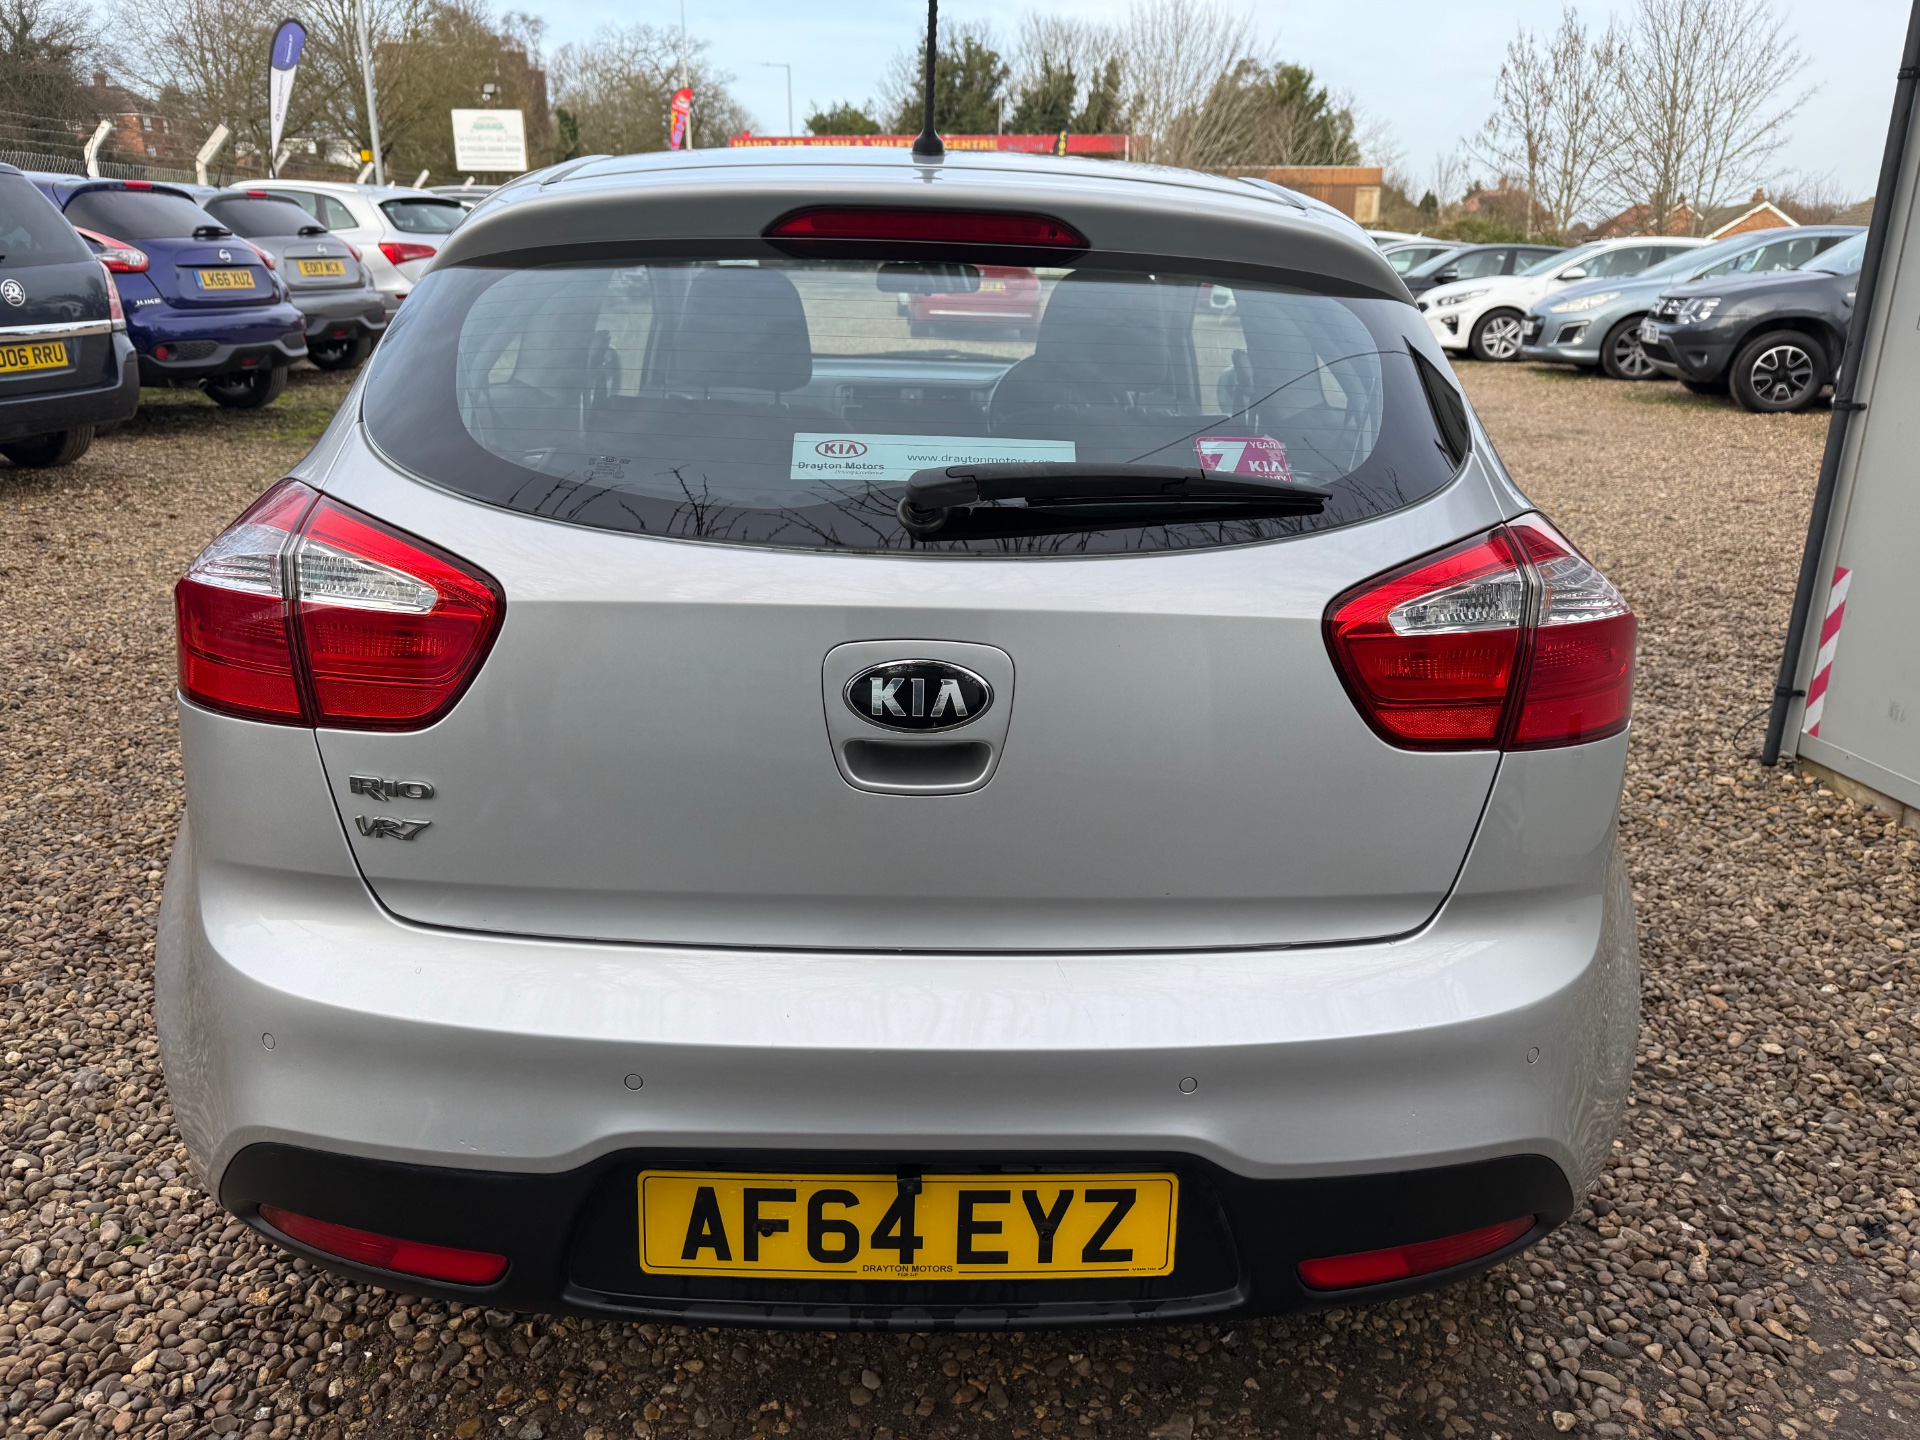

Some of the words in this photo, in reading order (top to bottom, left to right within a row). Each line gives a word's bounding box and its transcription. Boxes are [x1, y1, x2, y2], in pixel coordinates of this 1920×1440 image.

[733, 139, 773, 147] HAND
[810, 139, 851, 147] WASH
[944, 139, 997, 150] CENTRE
[201, 271, 231, 287] LK66
[231, 271, 253, 286] XUZ
[135, 297, 161, 307] JUKE
[31, 343, 64, 365] RRU
[824, 443, 859, 455] KIA
[1249, 441, 1277, 450] YEAR
[1199, 441, 1248, 474] 7
[798, 461, 842, 471] Drayton
[845, 462, 885, 470] Motors
[1248, 460, 1284, 473] KIA
[869, 676, 969, 718] KIA
[349, 774, 435, 801] RIO
[354, 814, 432, 841] VR7
[680, 1186, 923, 1265] AF64
[956, 1188, 1137, 1264] EYZ
[862, 1264, 909, 1273] DRAYTON
[911, 1265, 953, 1273] MOTORS
